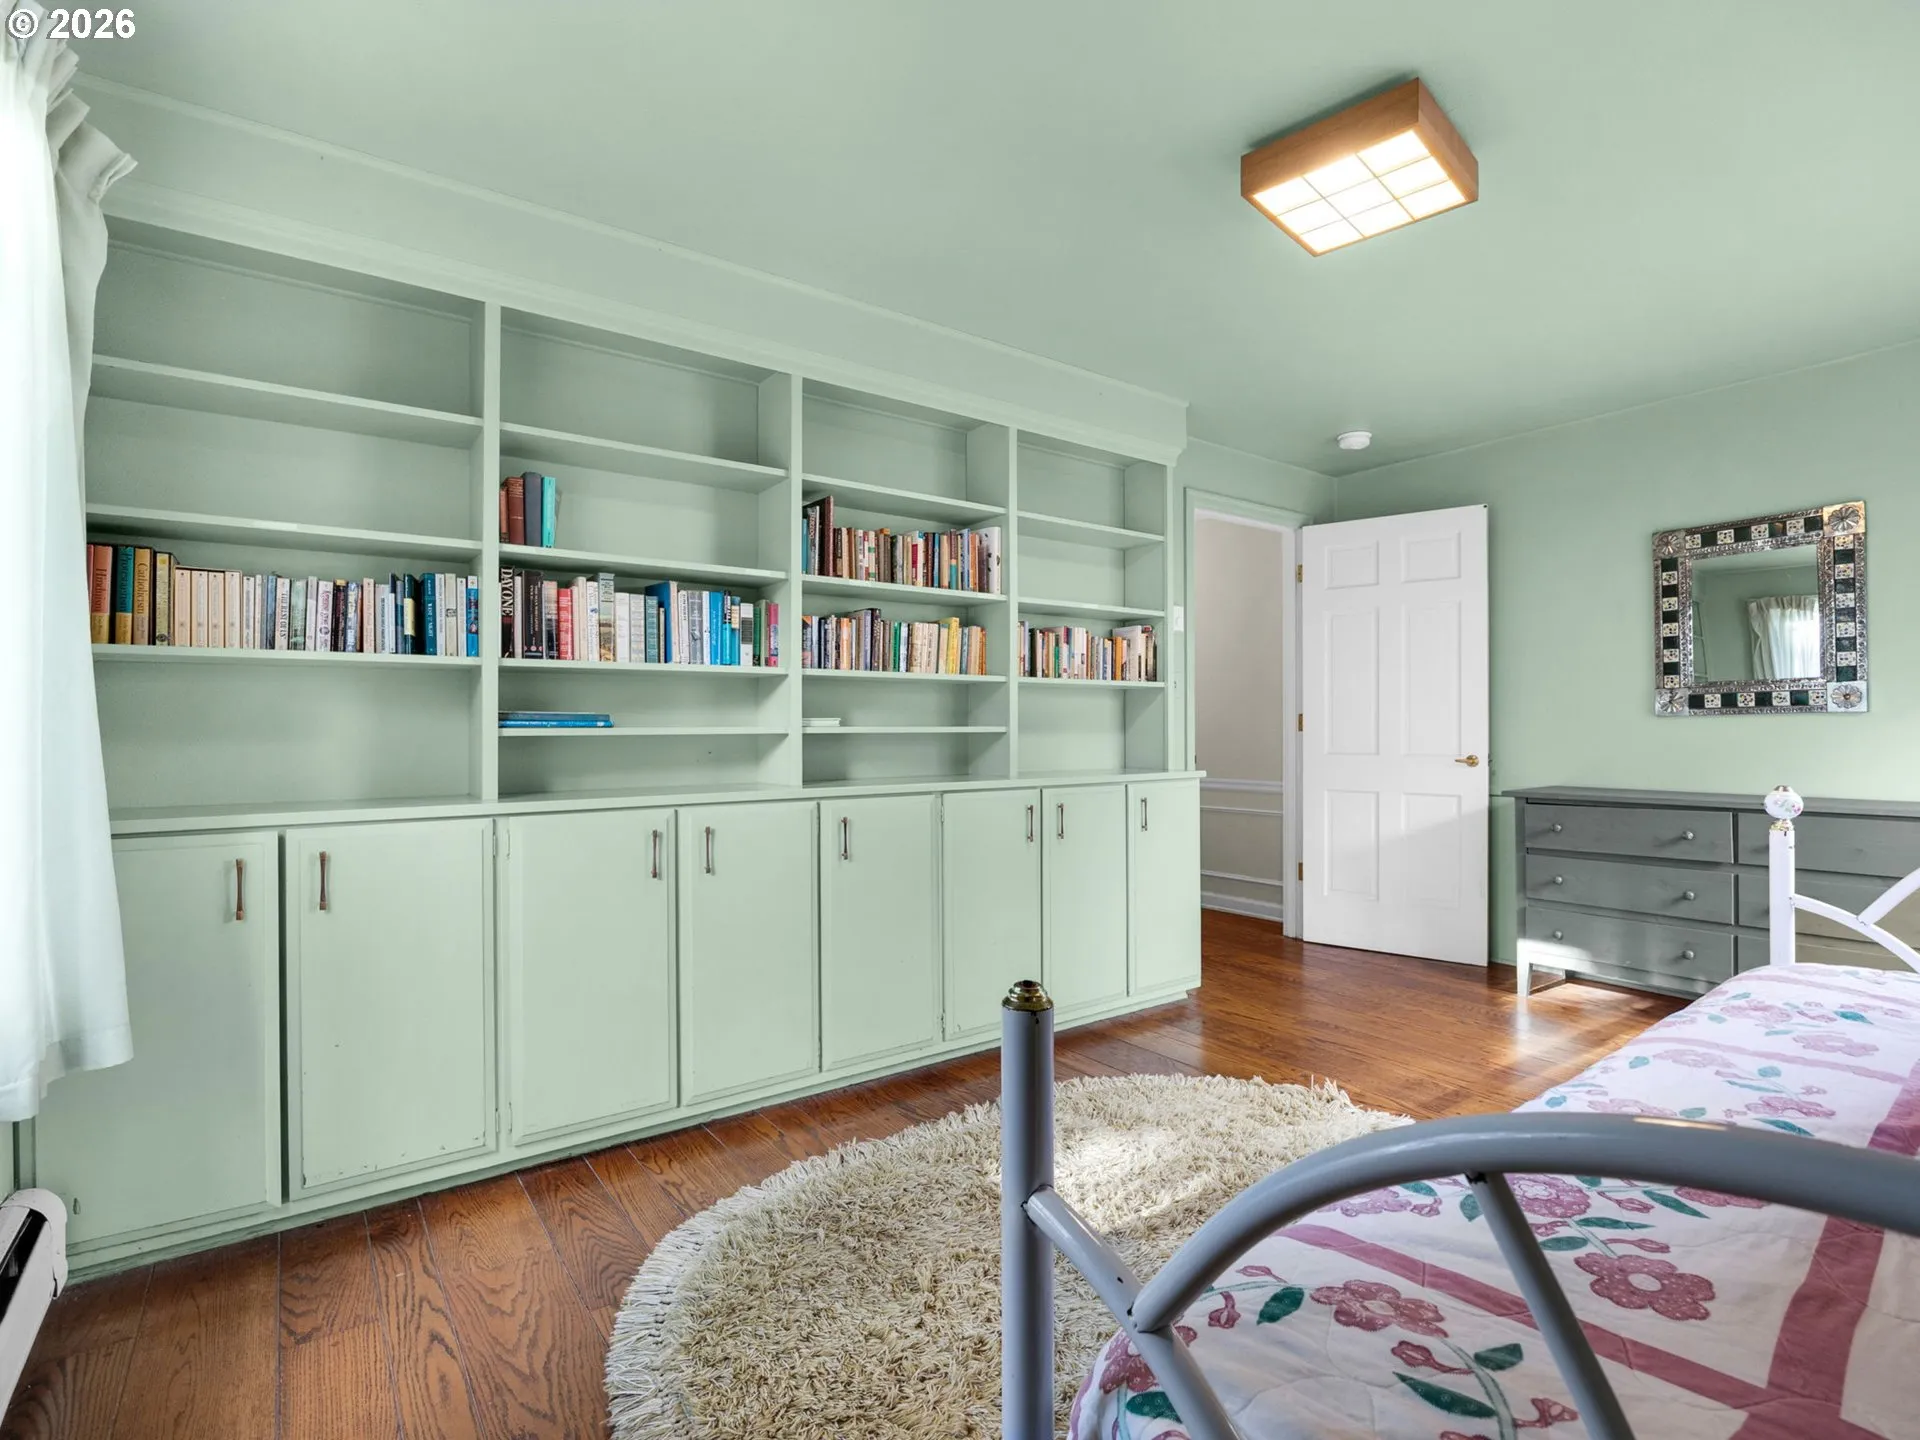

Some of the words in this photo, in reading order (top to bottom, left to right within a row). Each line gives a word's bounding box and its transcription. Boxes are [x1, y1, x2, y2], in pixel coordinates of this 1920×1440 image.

[92, 568, 107, 613] Hinduism
[119, 552, 133, 612] Protestantism
[136, 563, 149, 614] Catholicism
[501, 567, 514, 591] DAY
[501, 591, 514, 616] ONE
